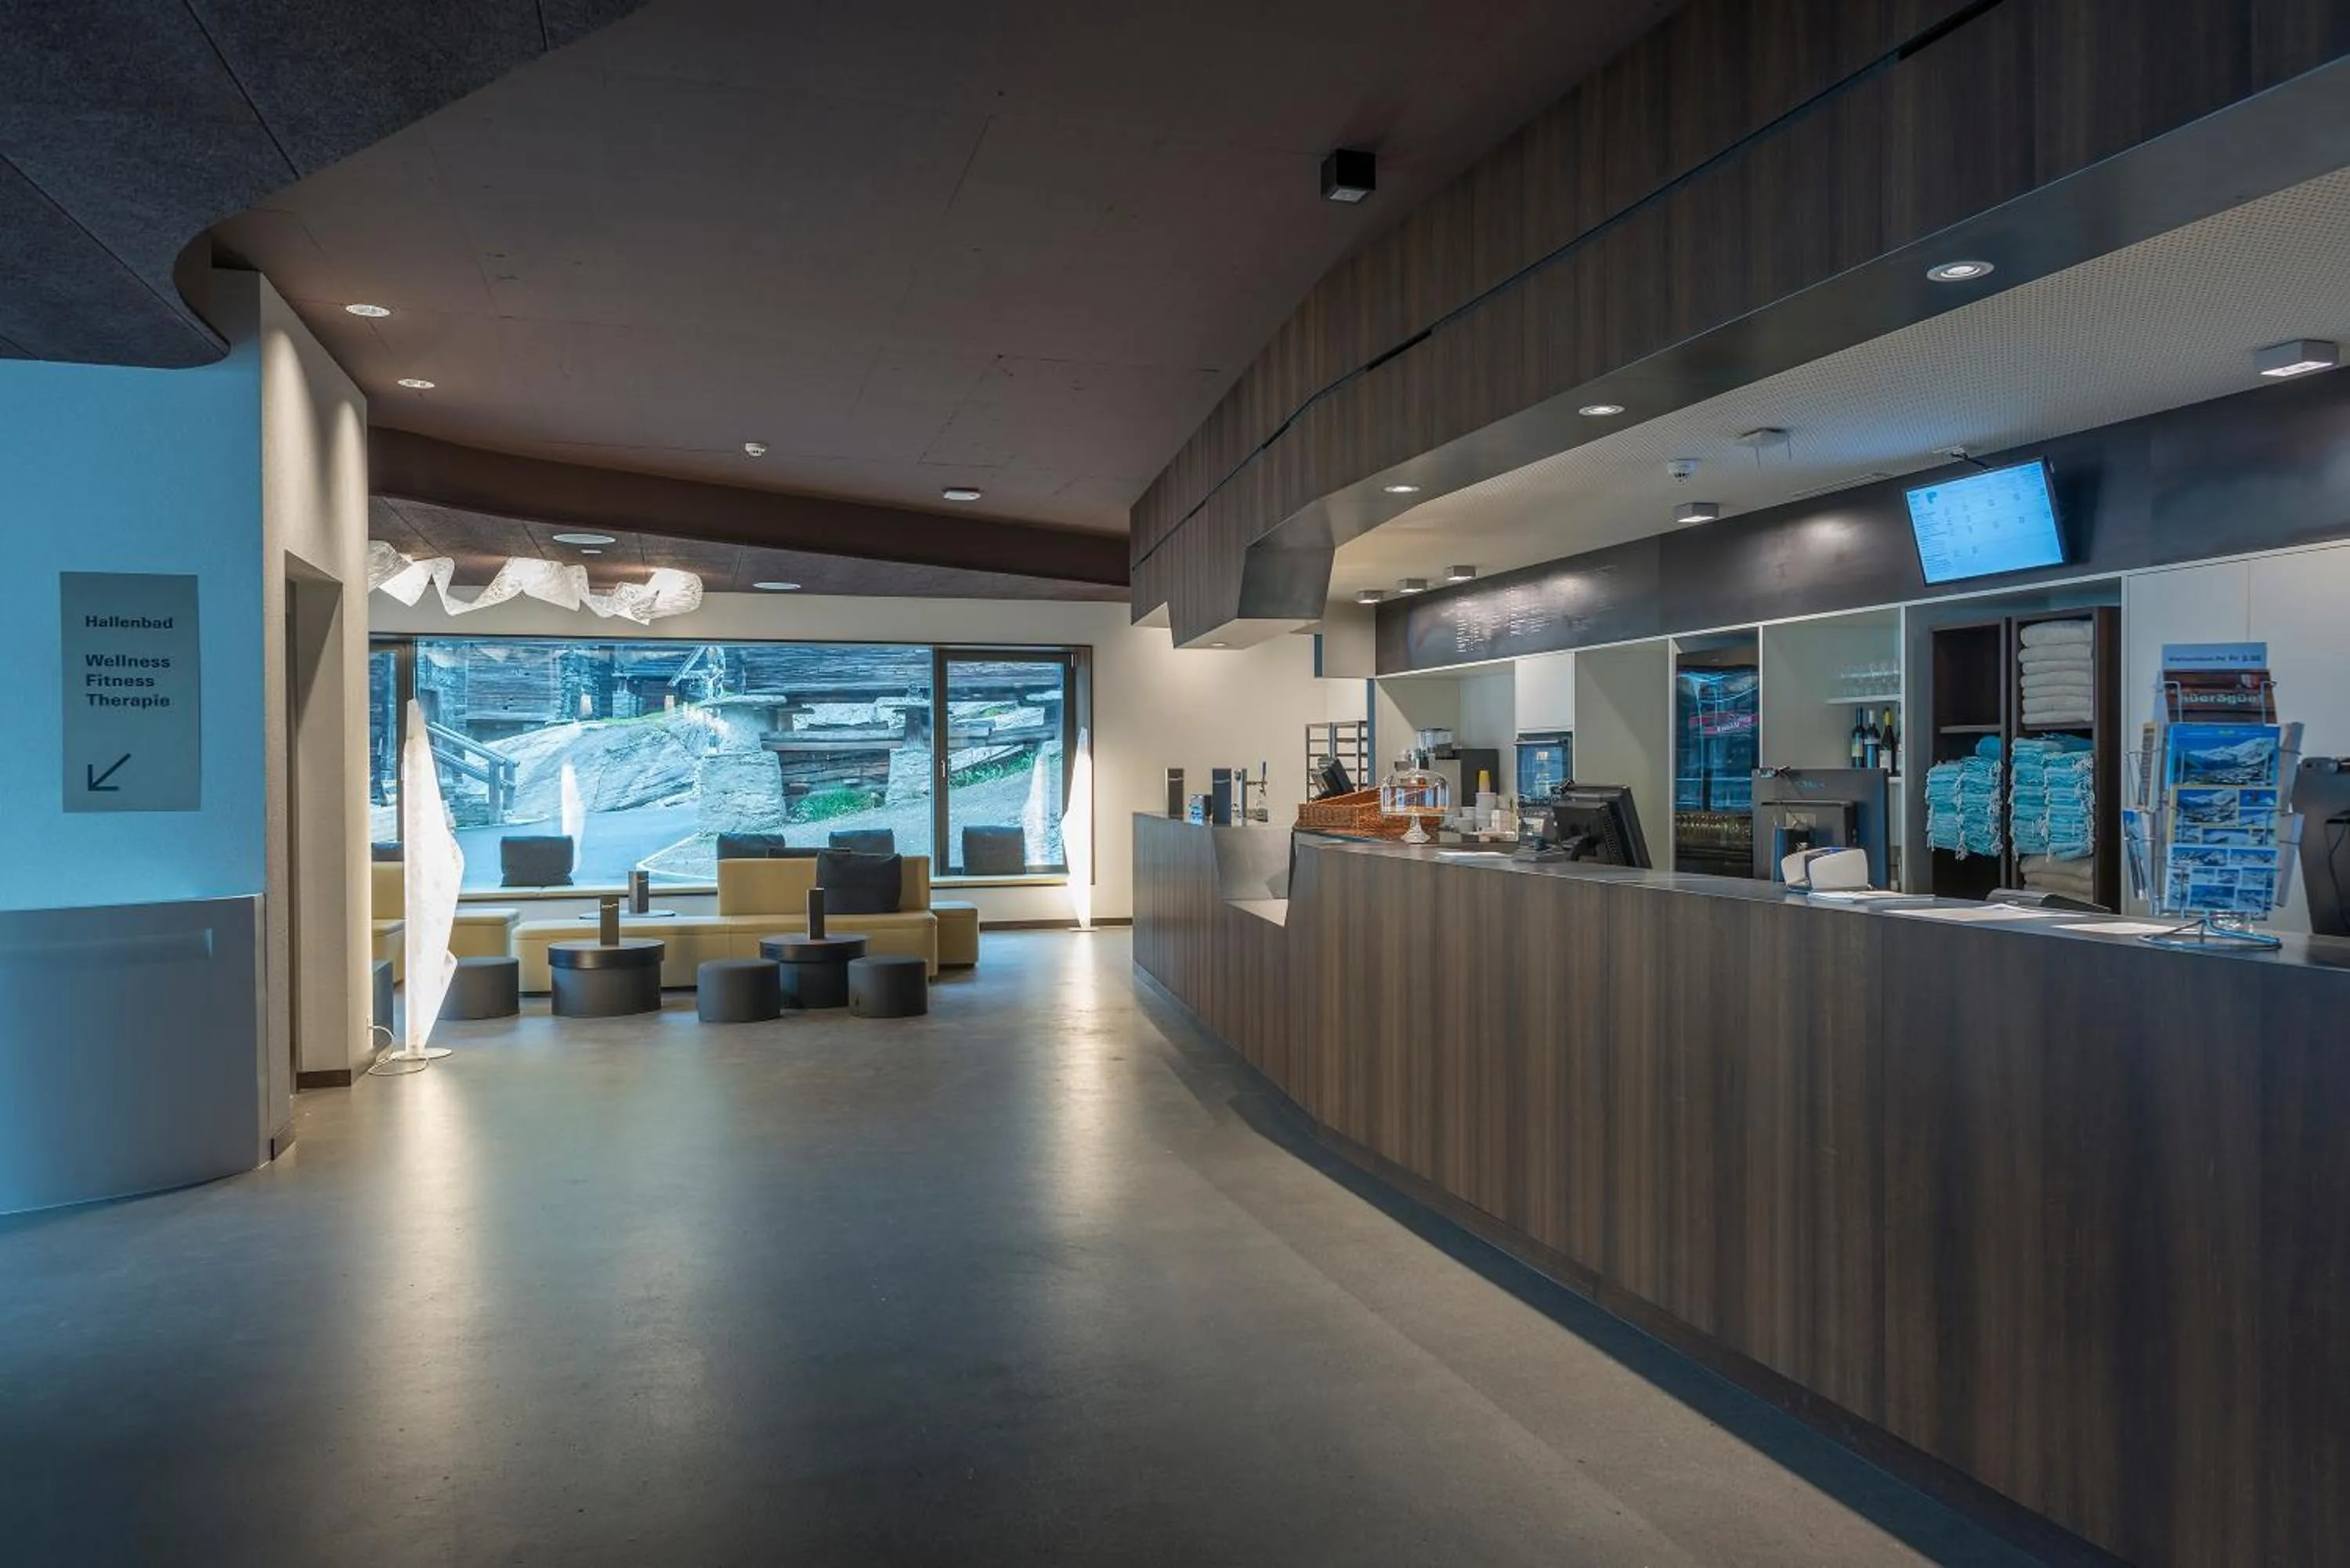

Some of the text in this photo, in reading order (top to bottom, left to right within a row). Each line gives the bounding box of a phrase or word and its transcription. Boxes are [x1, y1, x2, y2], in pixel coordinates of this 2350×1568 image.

[85, 615, 174, 629] Hallenbad
[85, 654, 171, 669] Wellness
[86, 674, 154, 688] Fitness
[86, 693, 170, 709] Therapie
